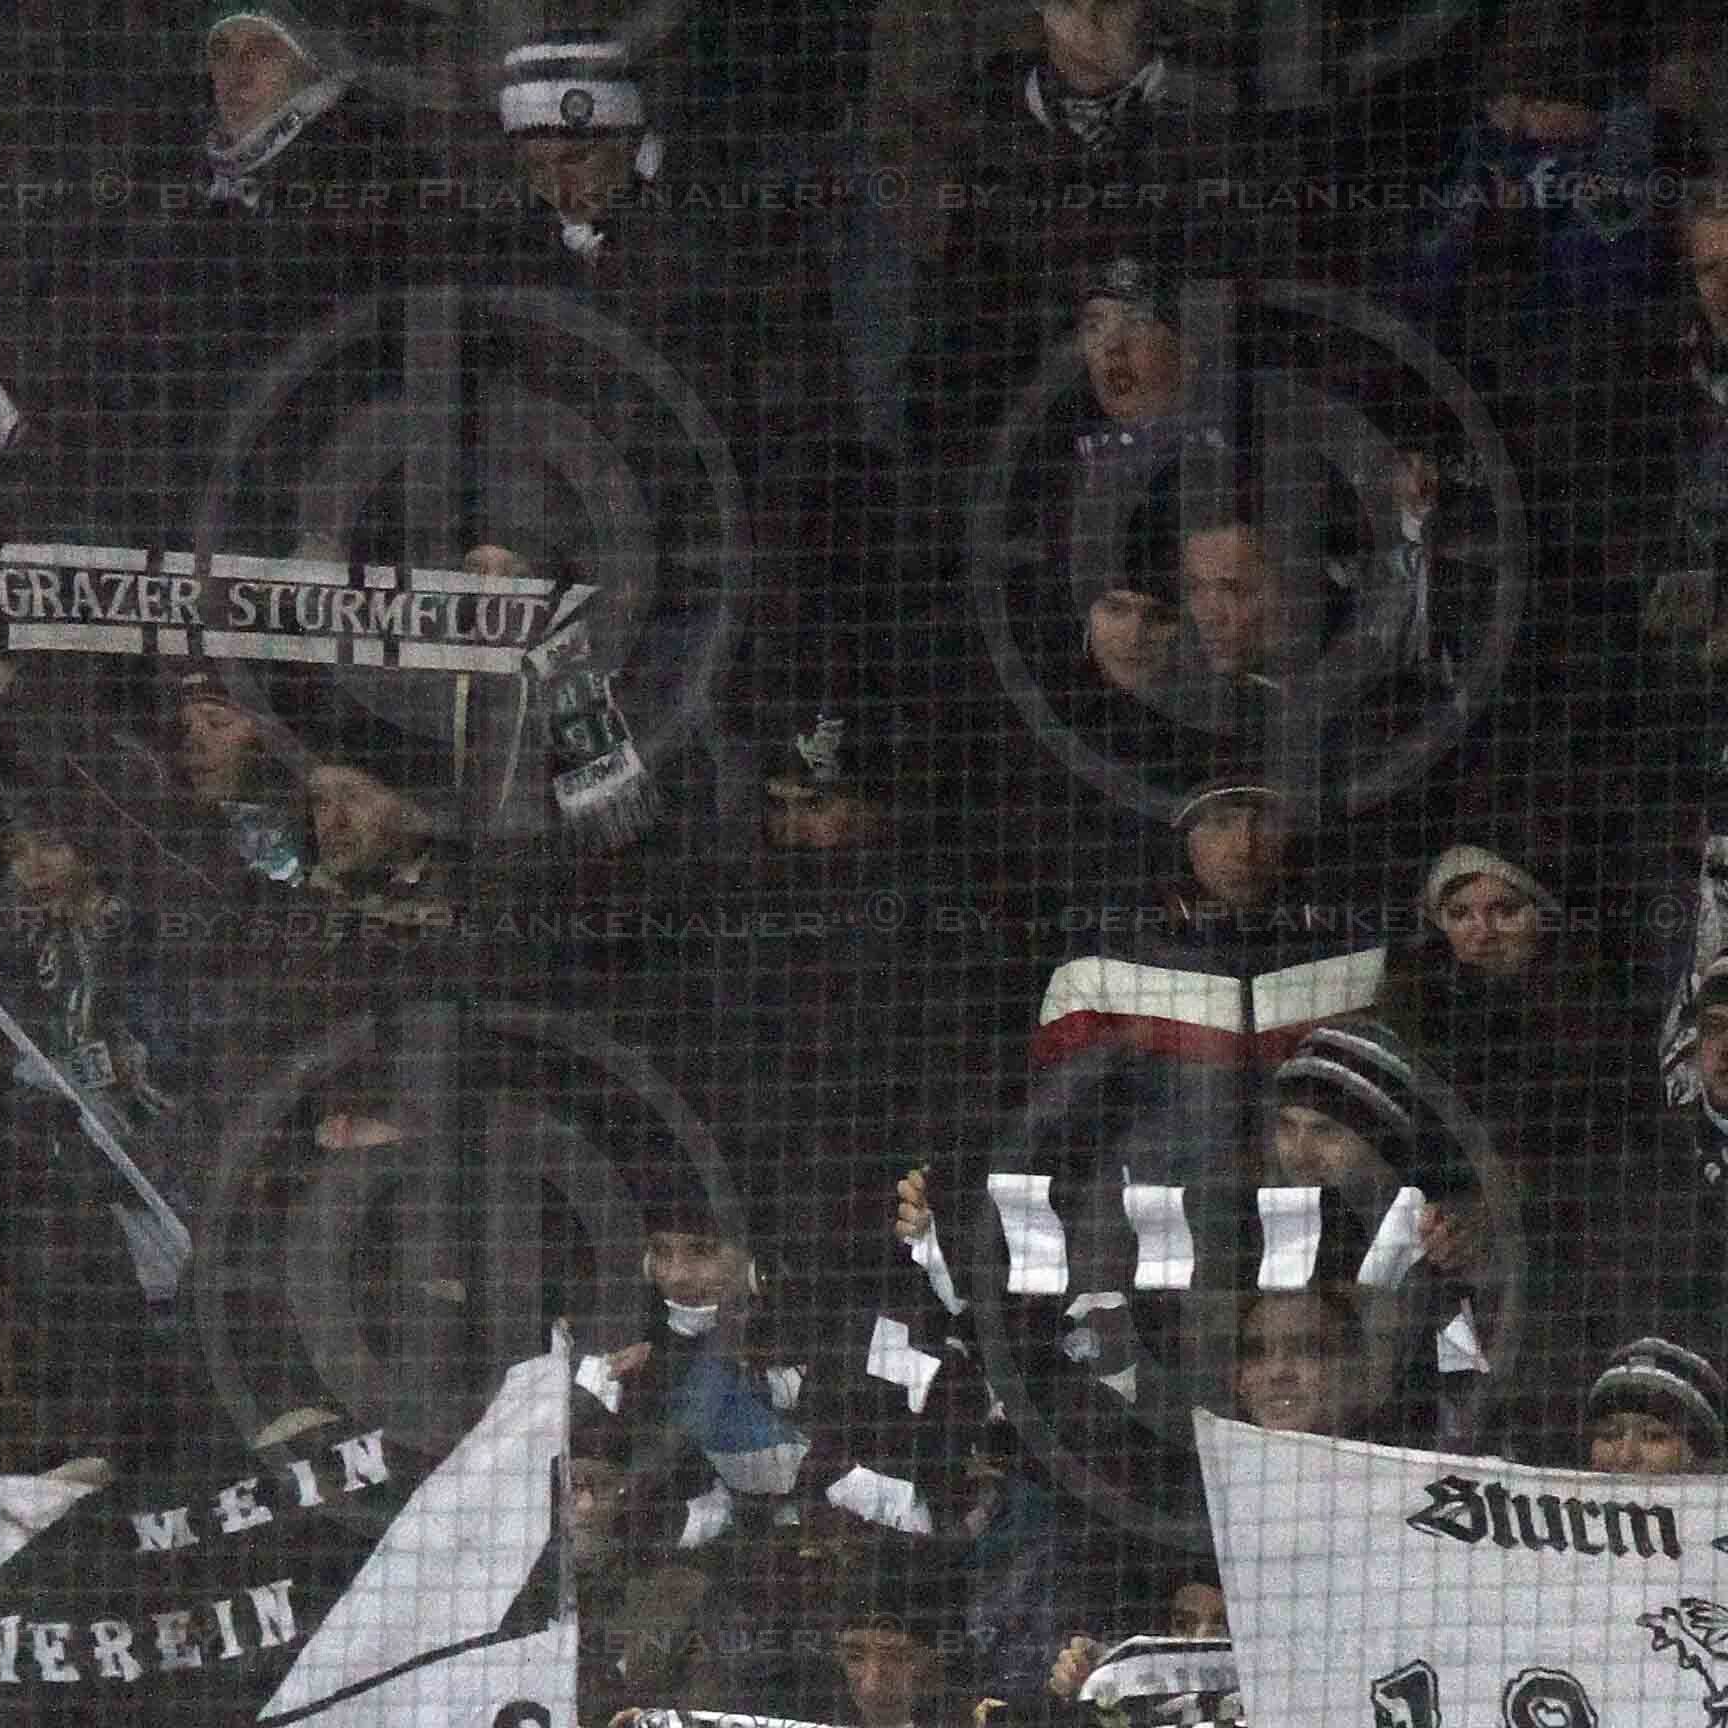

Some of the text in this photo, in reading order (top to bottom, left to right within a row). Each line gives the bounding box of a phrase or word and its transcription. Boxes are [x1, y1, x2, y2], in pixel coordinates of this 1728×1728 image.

[228, 582, 550, 643] STURMFLUT
[133, 1428, 393, 1553] MEIN
[1406, 1475, 1680, 1560] Sturm
